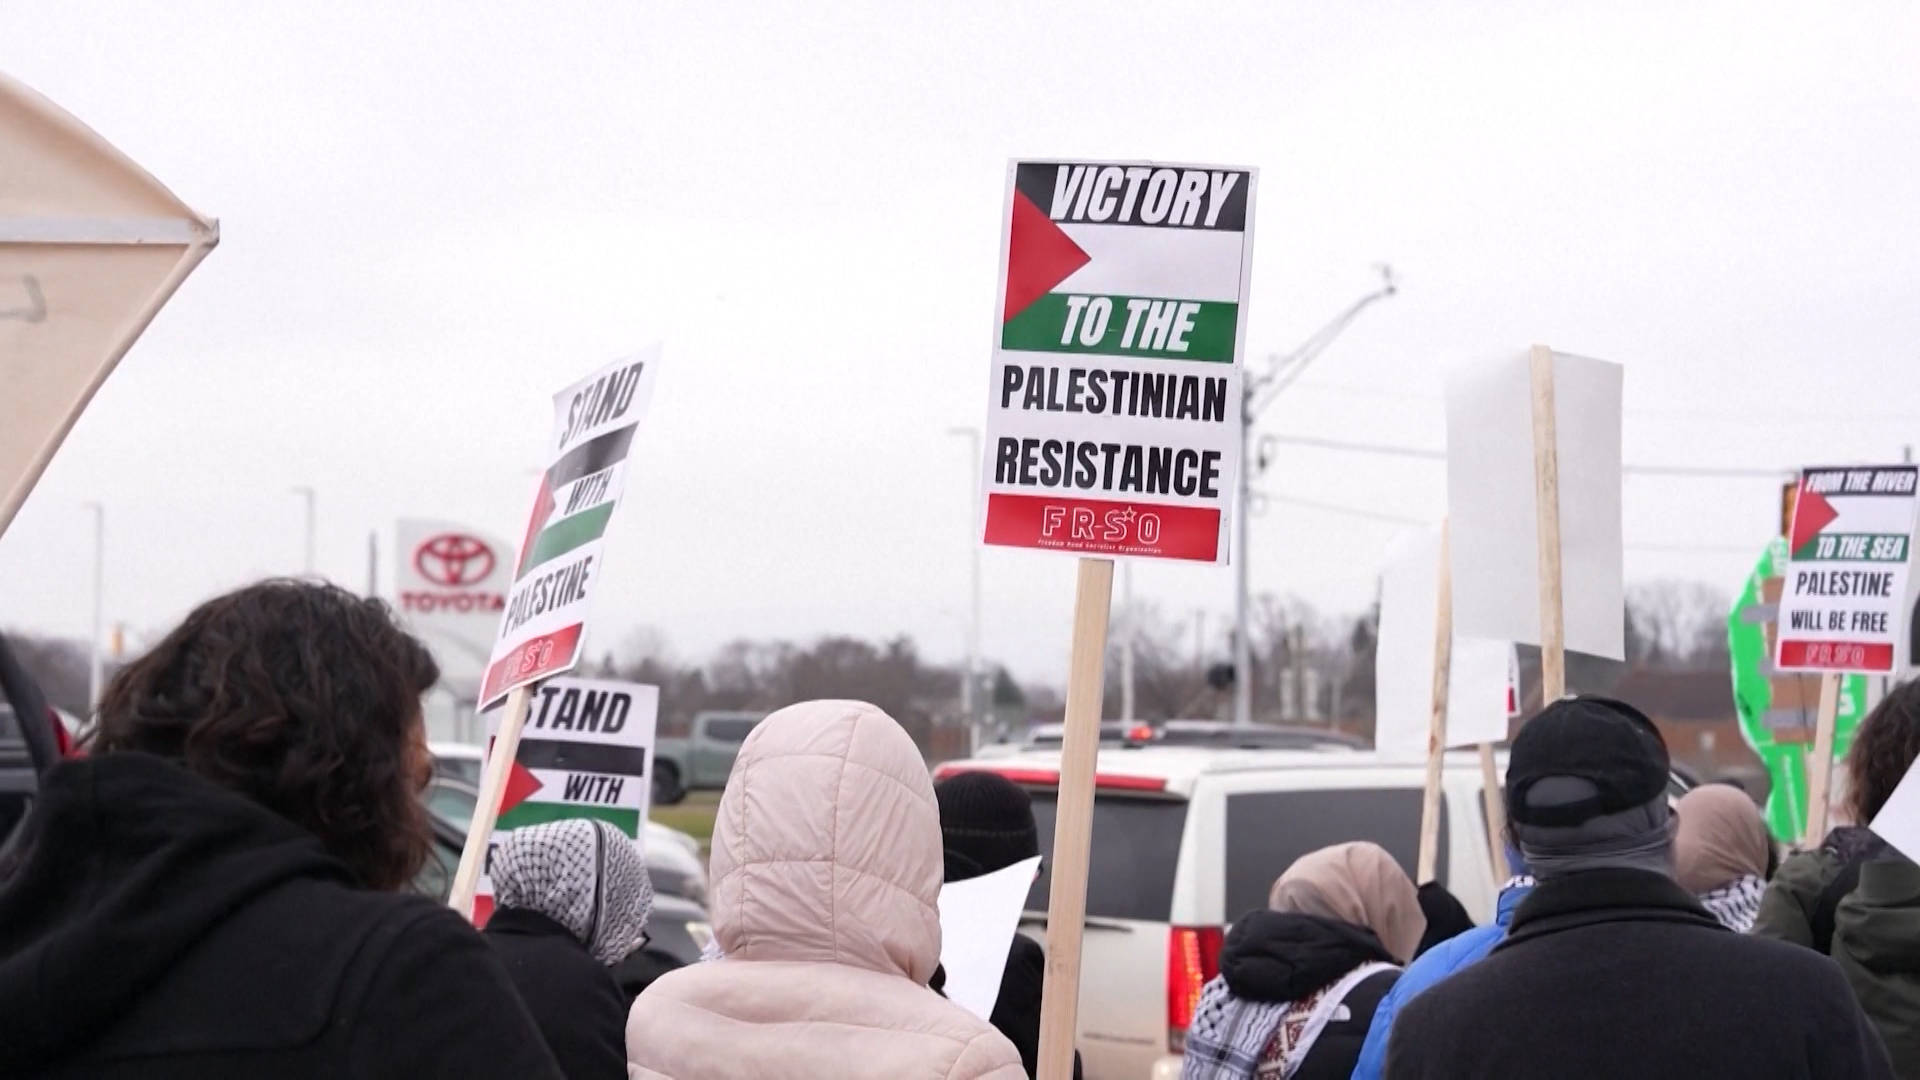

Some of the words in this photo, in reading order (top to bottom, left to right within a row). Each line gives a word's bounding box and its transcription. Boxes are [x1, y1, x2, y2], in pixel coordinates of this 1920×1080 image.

[1050, 165, 1239, 227] VICTORY
[1061, 296, 1112, 346] TO
[1121, 300, 1200, 352] THE
[559, 361, 644, 450] STAND
[1001, 365, 1227, 422] PALESTINIAN
[563, 467, 614, 516] WITH
[995, 437, 1221, 498] RESISTANCE
[1845, 471, 1870, 492] THE
[1872, 471, 1917, 492] RIVER
[1816, 536, 1836, 558] TO
[1838, 536, 1867, 559] THE
[1870, 536, 1904, 560] SEA
[402, 592, 505, 613] TOYOTA
[502, 555, 593, 639] PALESTINE
[1795, 571, 1894, 597] PALESTINE
[1791, 610, 1822, 631] WILL
[1829, 611, 1846, 631] BE
[1851, 611, 1888, 633] FREE
[563, 773, 624, 805] WITH
